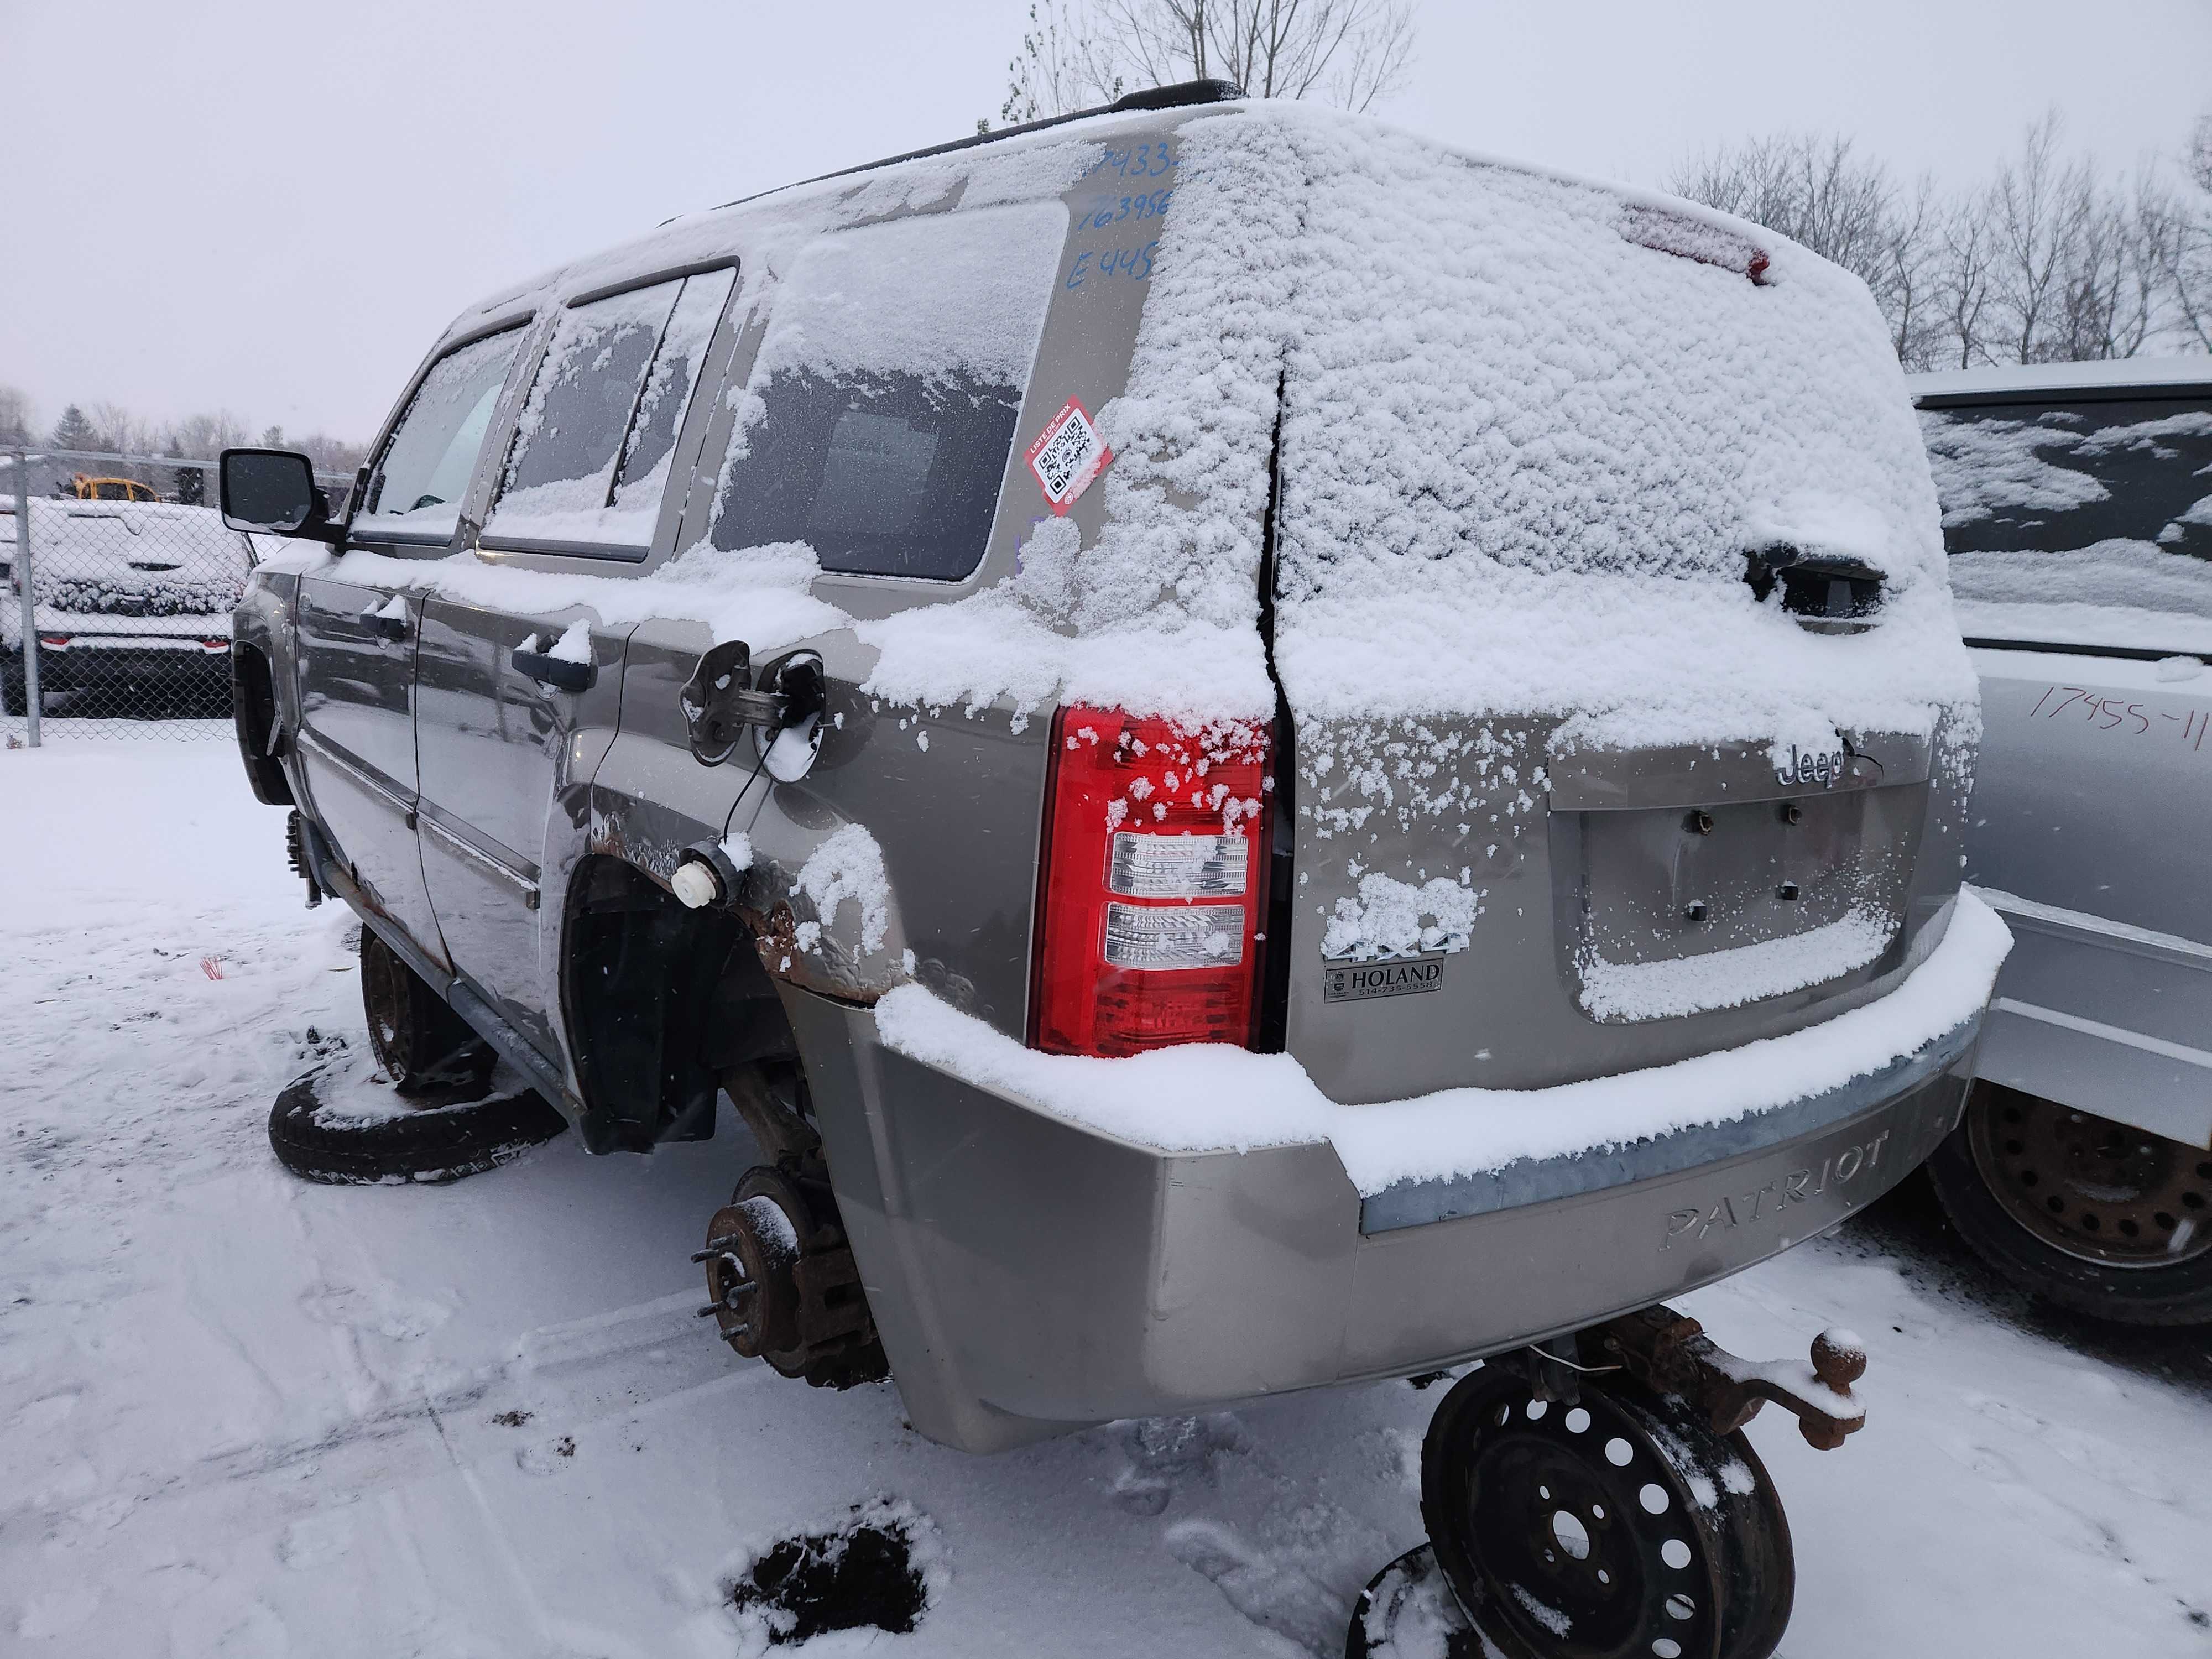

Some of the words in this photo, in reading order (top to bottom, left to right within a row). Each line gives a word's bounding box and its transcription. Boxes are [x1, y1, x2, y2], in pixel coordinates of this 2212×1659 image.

[1030, 431, 1047, 453] LISTE
[1046, 420, 1057, 434] DE
[1055, 403, 1071, 422] PRIX
[1776, 744, 1843, 789] Jeep
[1352, 964, 1439, 989] HOLAND
[1359, 982, 1433, 995] 514-735-5558
[1659, 1129, 1890, 1251] PATRIOT
